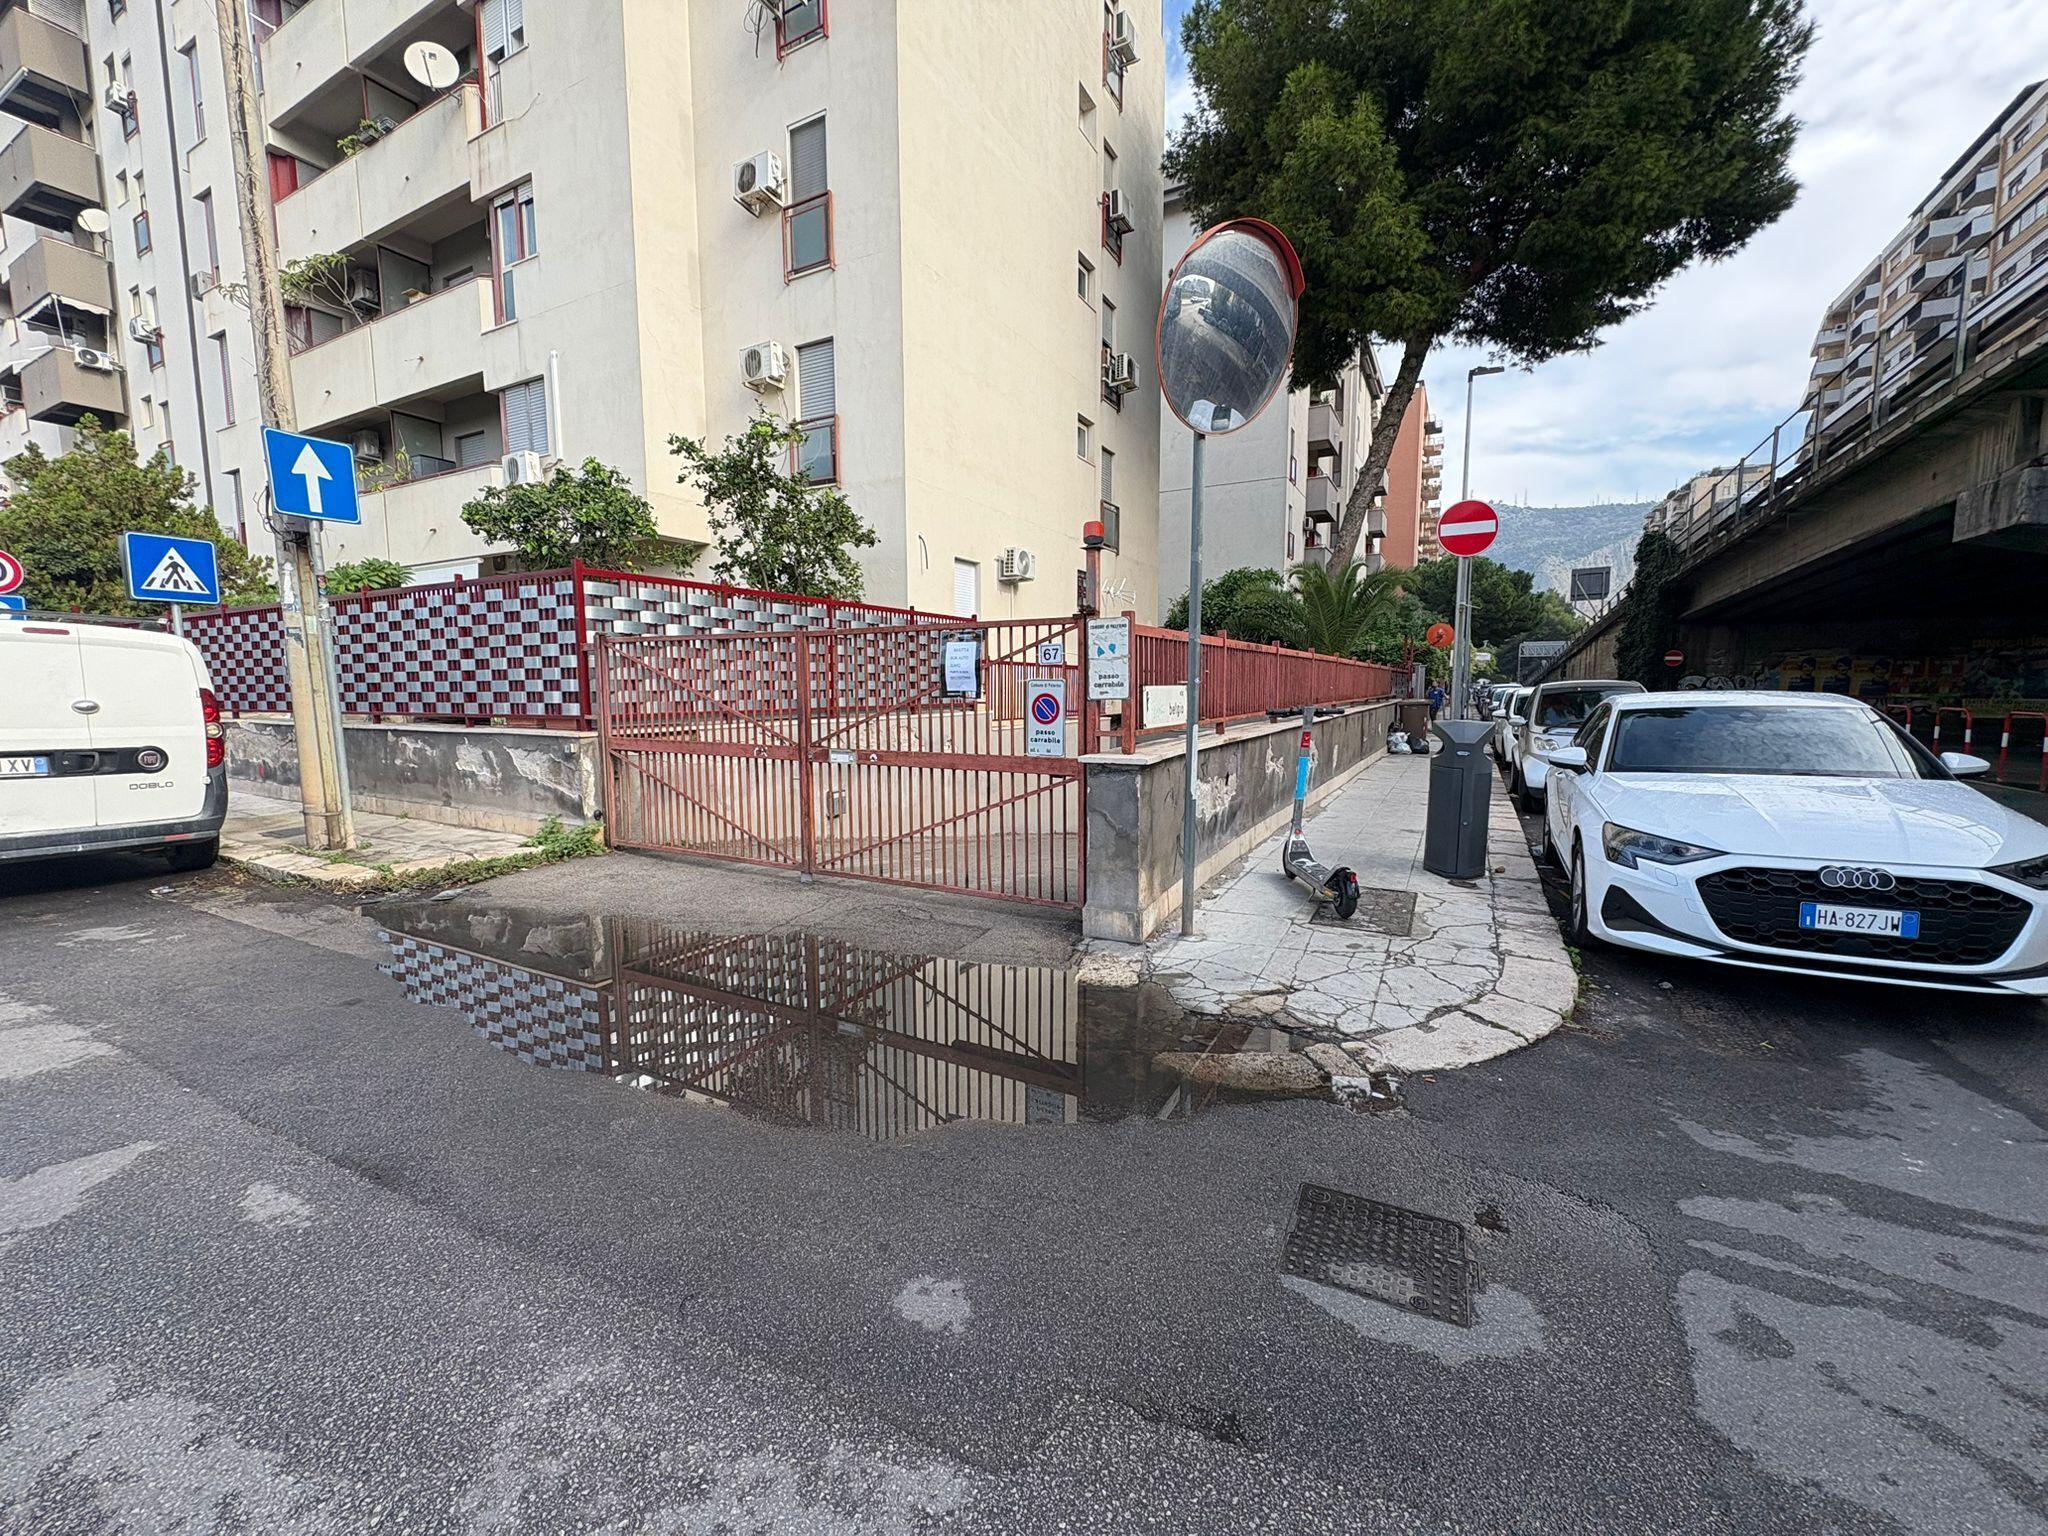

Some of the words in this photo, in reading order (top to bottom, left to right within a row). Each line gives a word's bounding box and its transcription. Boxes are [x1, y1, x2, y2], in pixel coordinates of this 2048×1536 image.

[1043, 647, 1059, 661] 67
[1098, 673, 1120, 681] passo
[1035, 729, 1056, 737] passo
[129, 781, 174, 790] DOBLO
